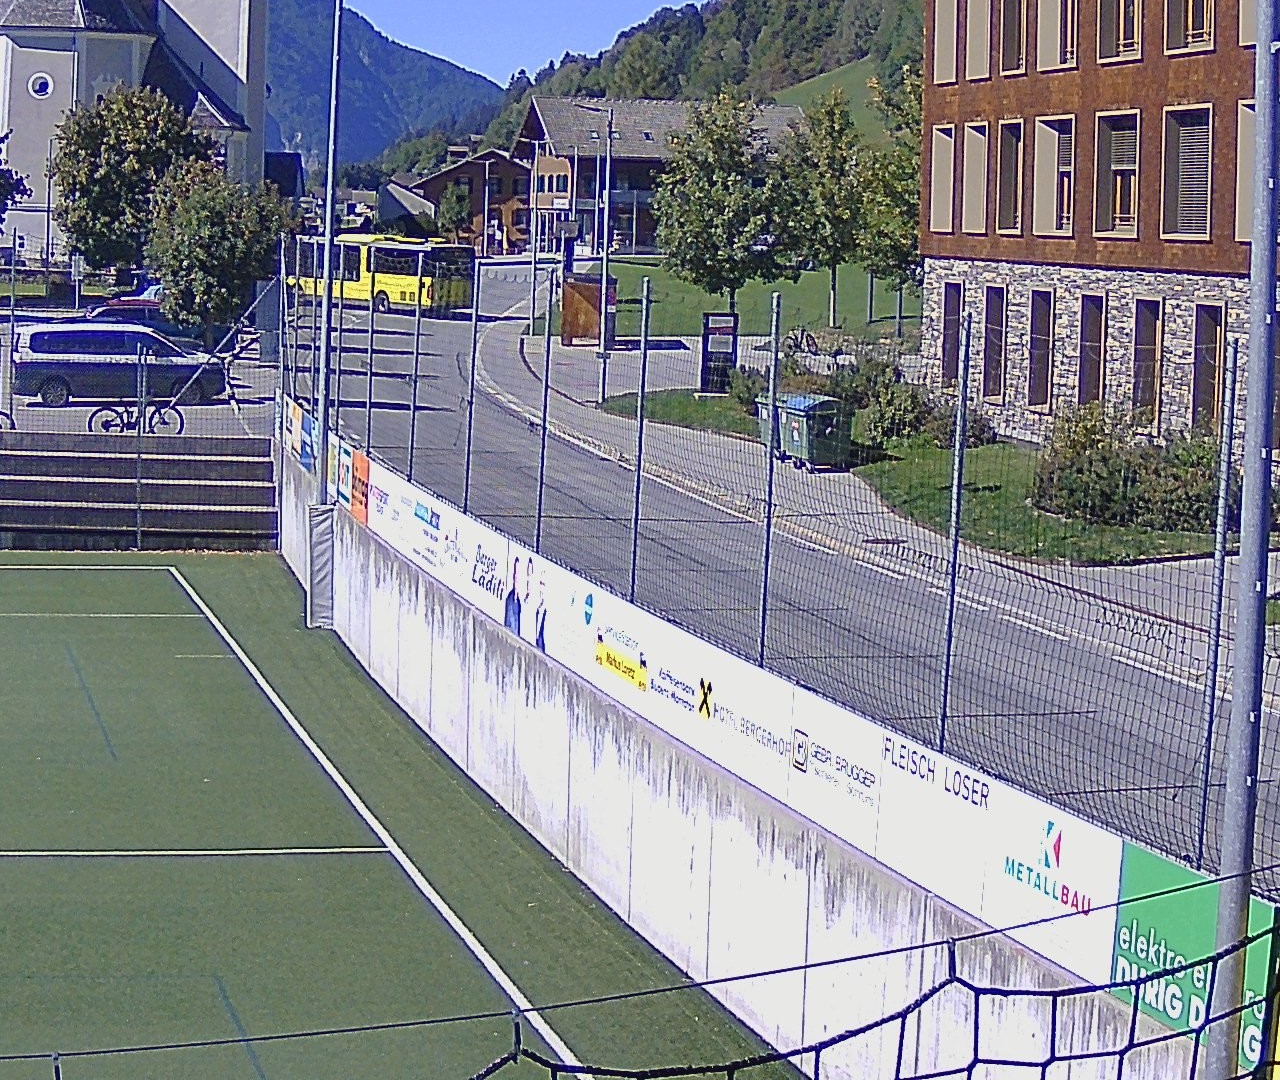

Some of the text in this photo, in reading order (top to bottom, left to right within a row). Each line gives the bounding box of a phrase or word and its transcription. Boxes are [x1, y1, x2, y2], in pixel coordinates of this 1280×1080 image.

[883, 736, 990, 809] FLEISCH LOSER
[1005, 856, 1091, 917] METALLBAU
[1119, 918, 1186, 979] elektro
